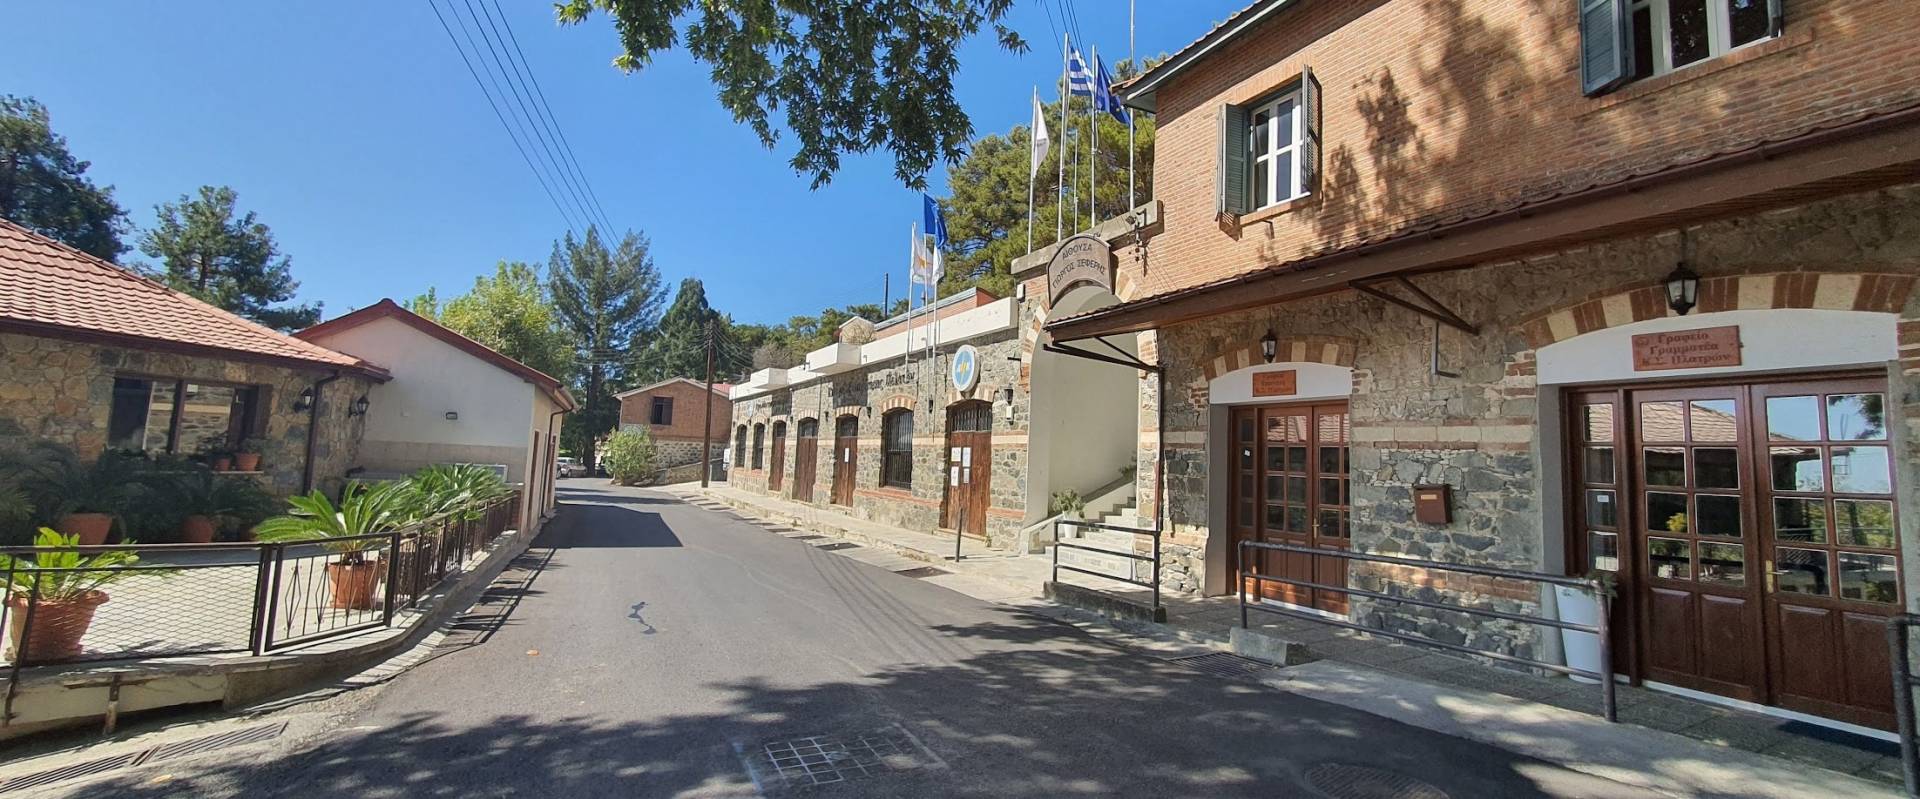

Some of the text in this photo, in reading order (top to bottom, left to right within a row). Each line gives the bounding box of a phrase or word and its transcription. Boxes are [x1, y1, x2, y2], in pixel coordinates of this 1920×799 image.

[1062, 243, 1092, 260] ΑΙΘΟΥΣΑ
[1658, 332, 1709, 345] Γραφείο
[1650, 343, 1719, 356] Γραμματέα
